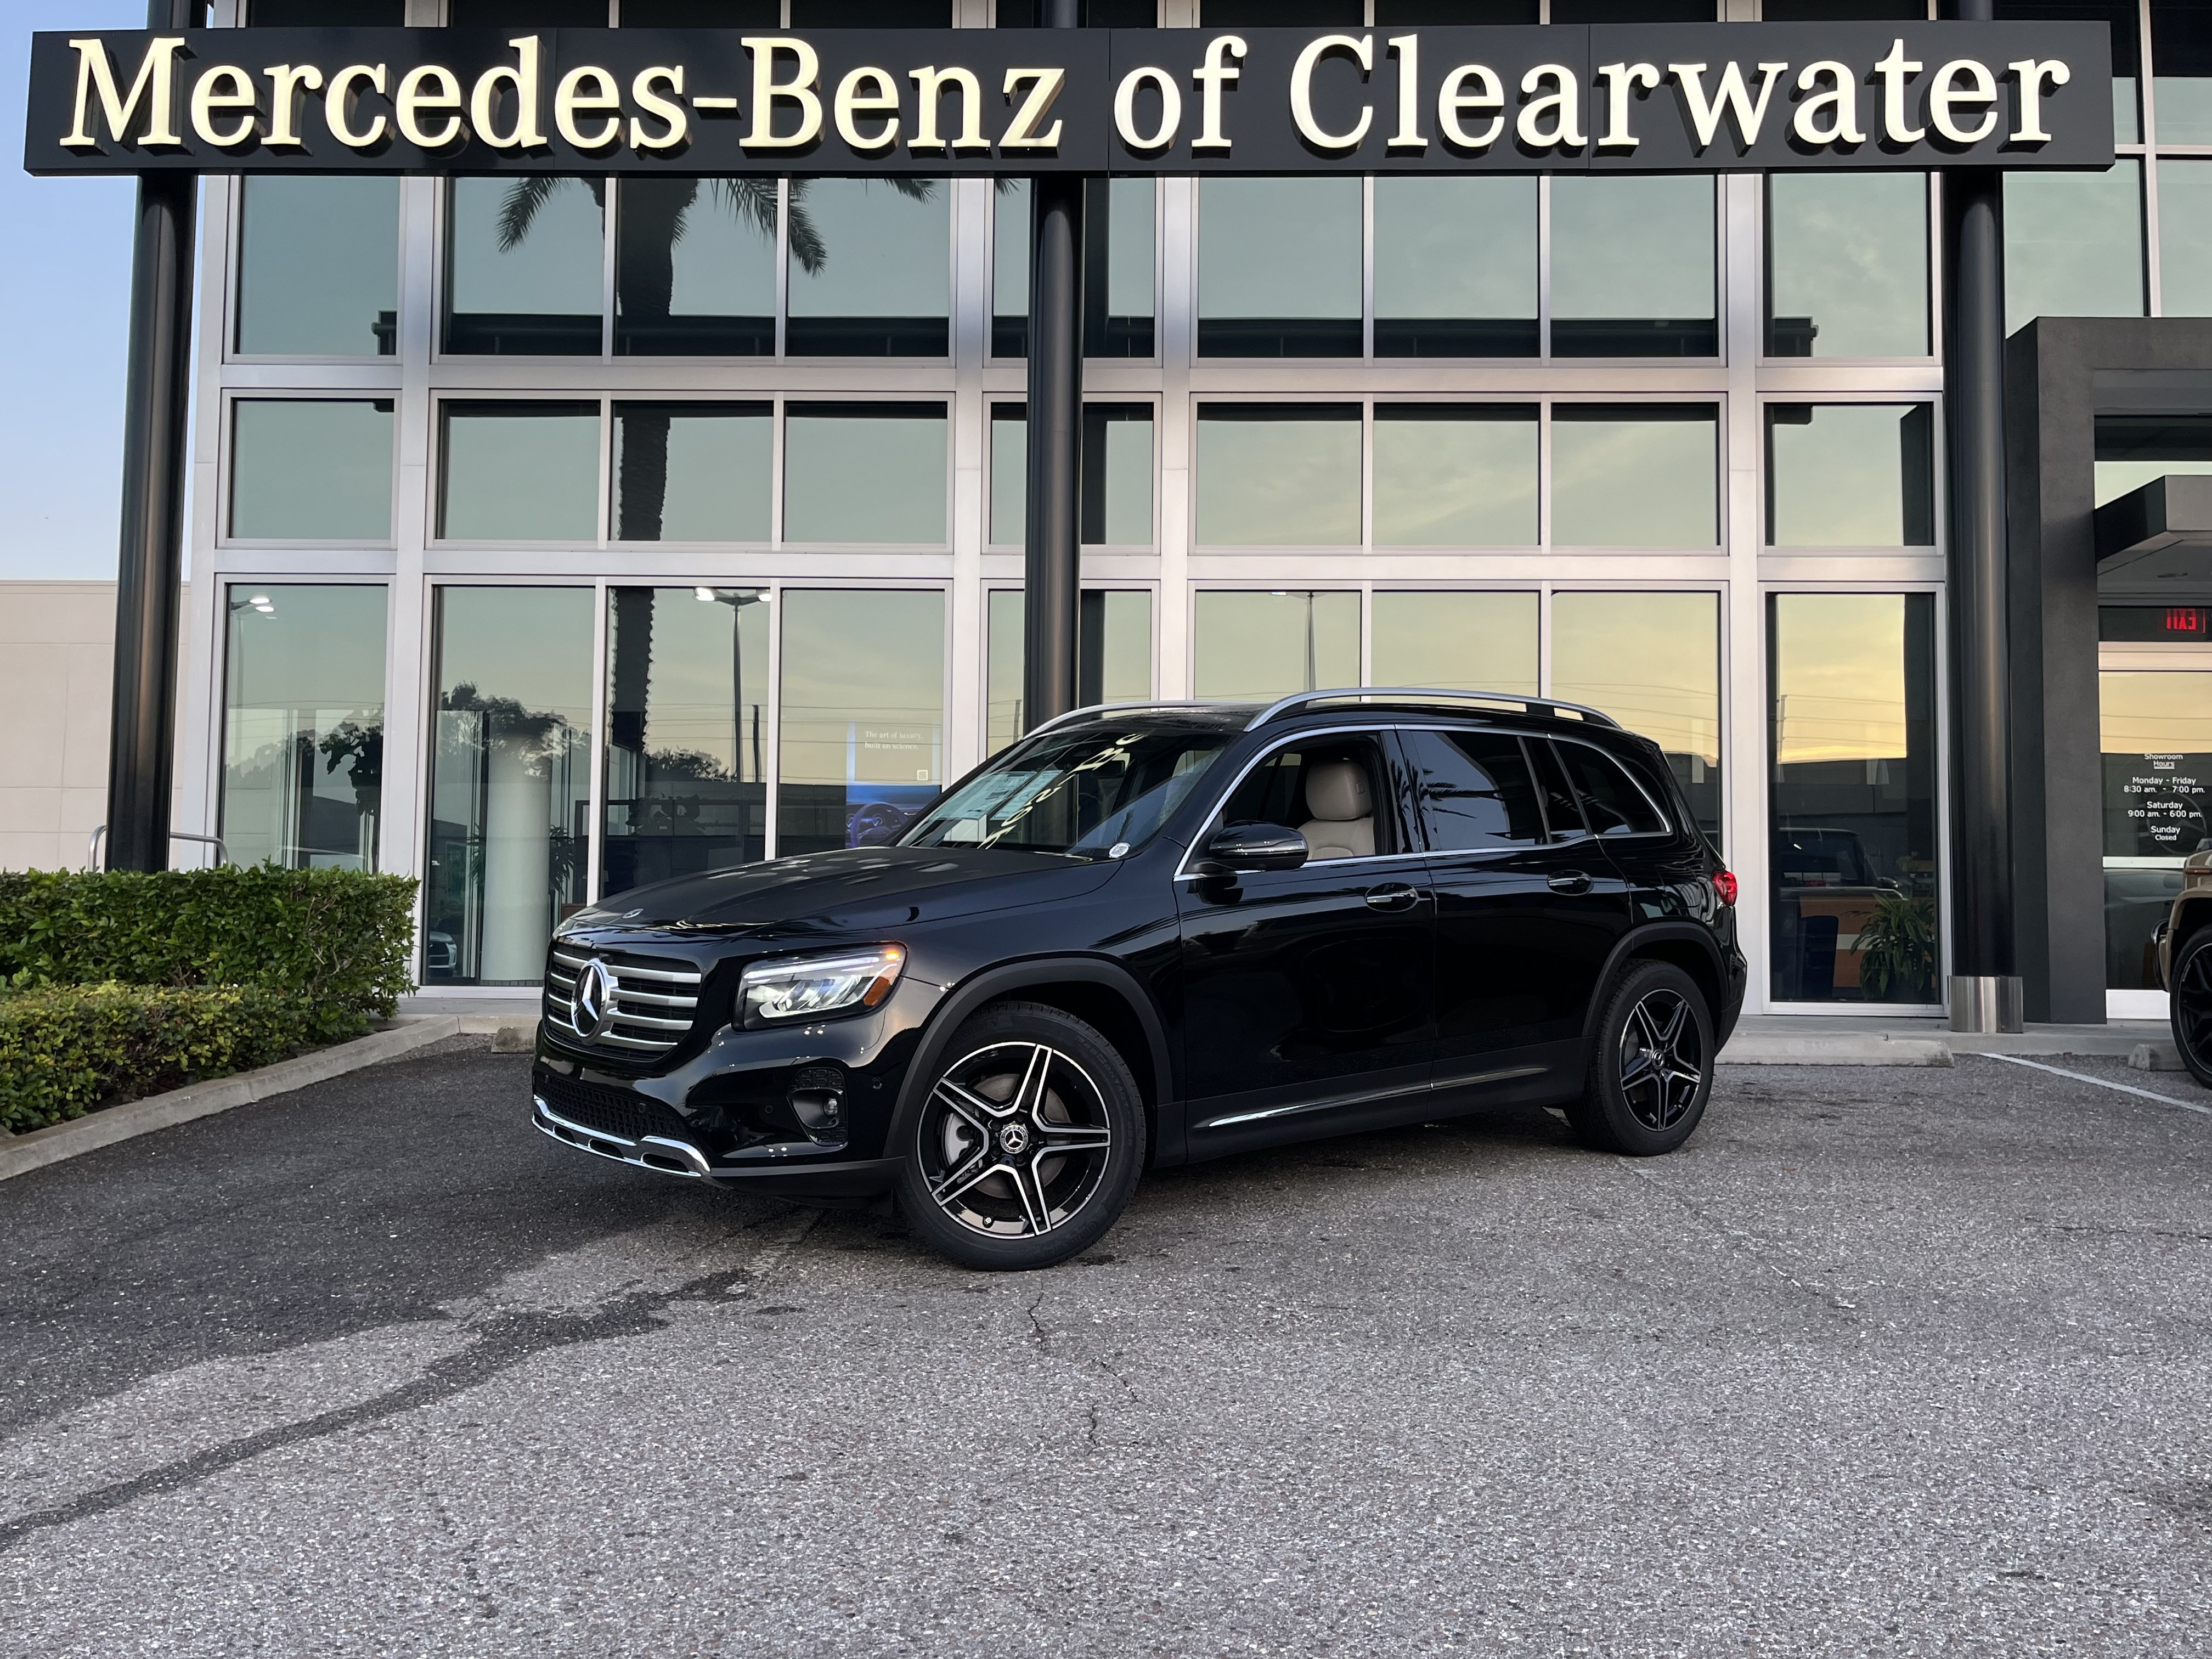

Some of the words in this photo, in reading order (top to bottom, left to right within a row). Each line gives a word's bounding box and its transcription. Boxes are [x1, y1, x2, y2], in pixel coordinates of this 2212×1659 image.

[59, 35, 1065, 149] Mercedes-Benz
[1114, 35, 1248, 148] of
[1290, 33, 2070, 148] Clearwater
[899, 732, 923, 741] luxury,
[2132, 776, 2163, 785] Monday
[2172, 776, 2197, 785] Friday
[2147, 801, 2183, 810] Saturday
[2151, 826, 2181, 834] Sunday
